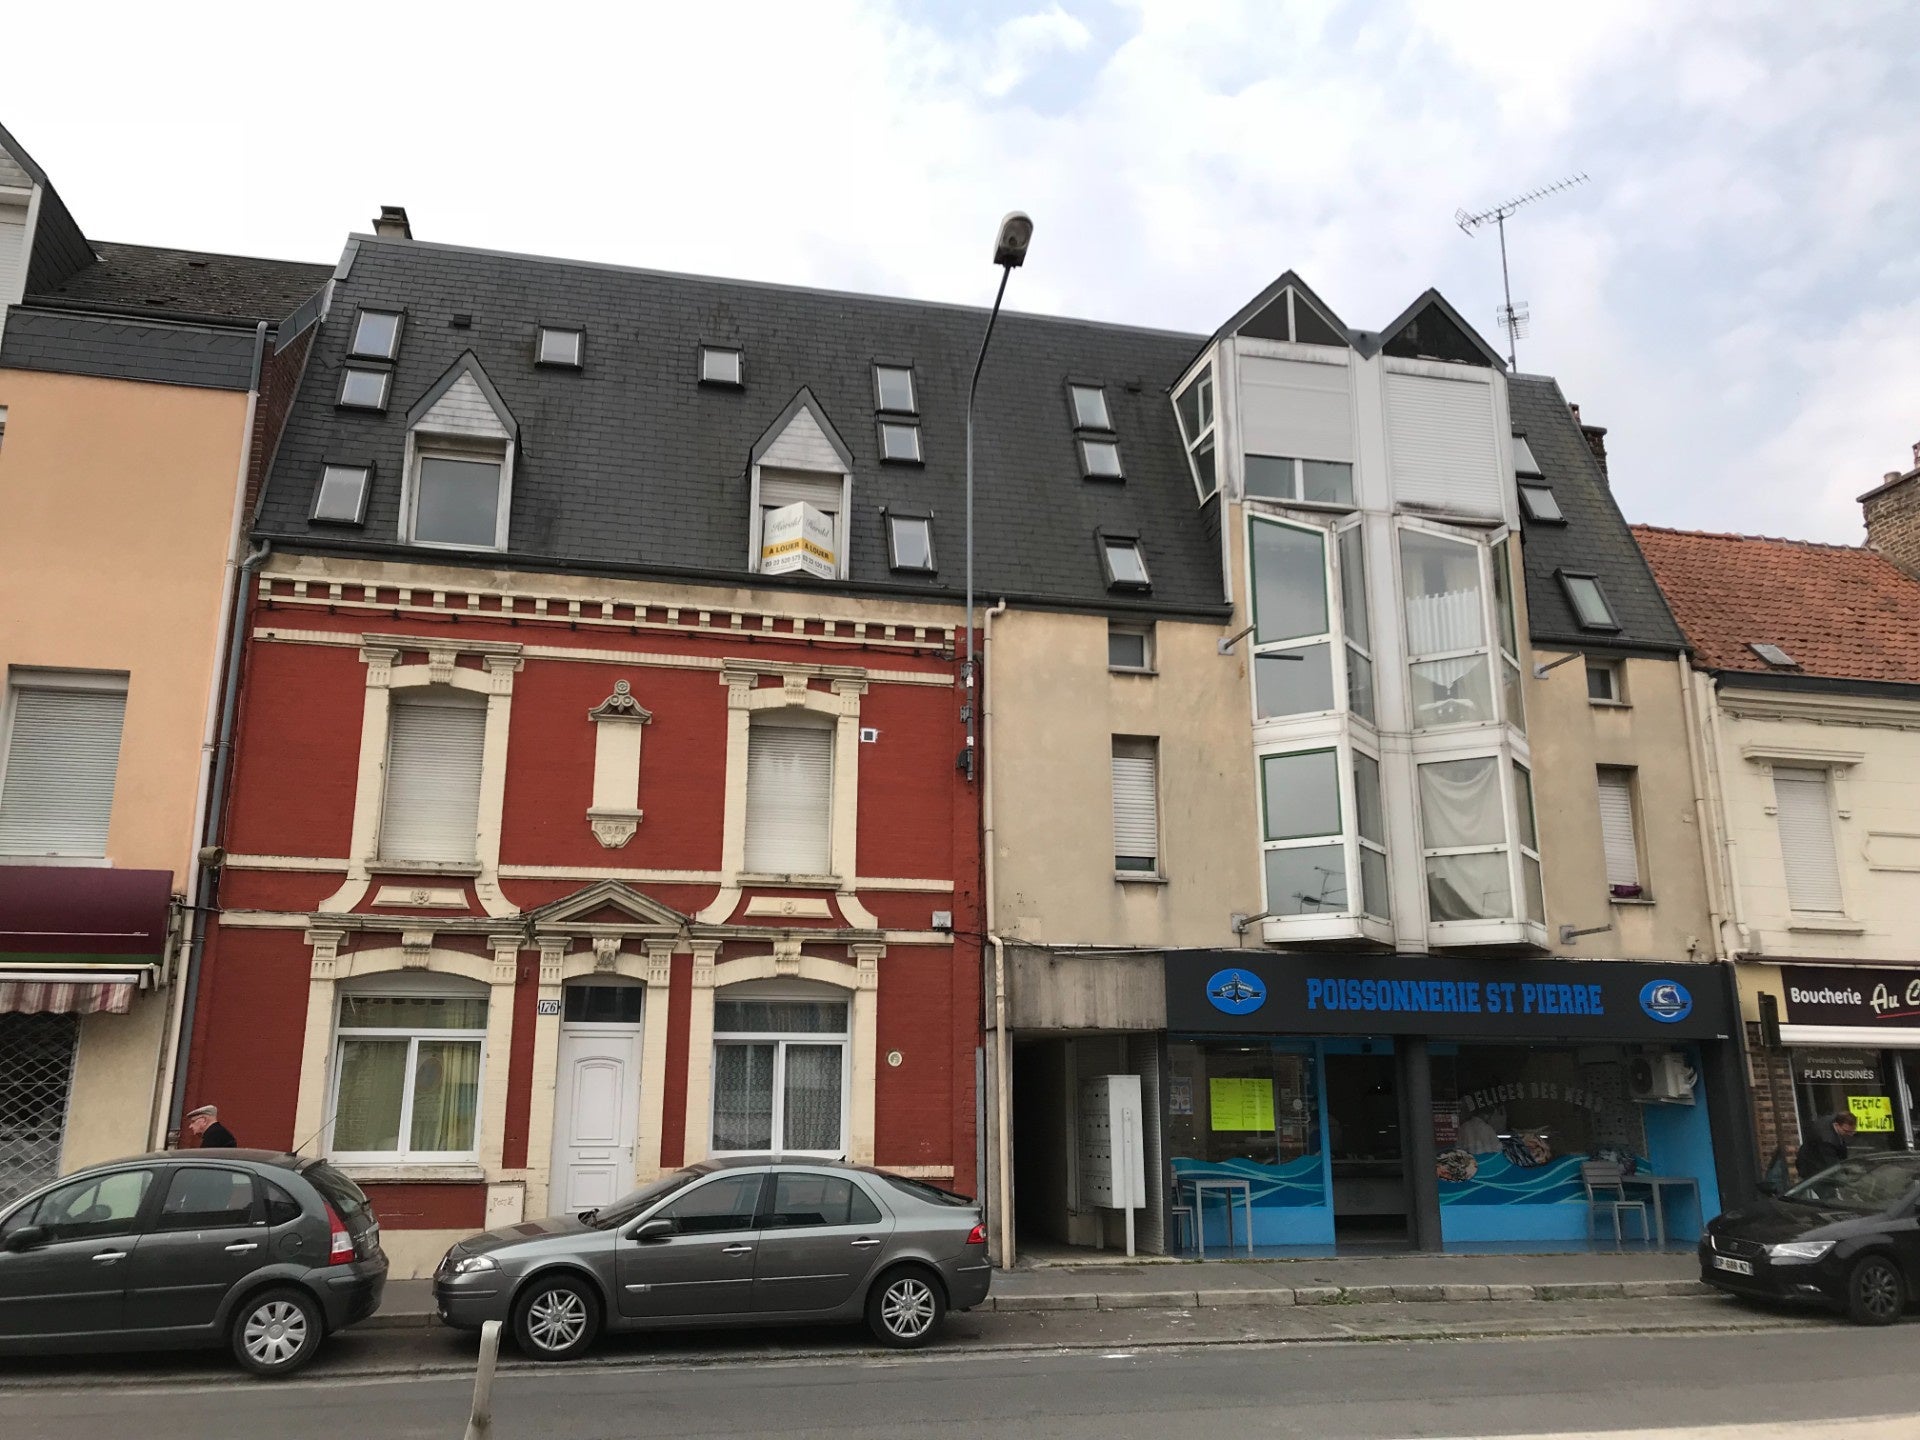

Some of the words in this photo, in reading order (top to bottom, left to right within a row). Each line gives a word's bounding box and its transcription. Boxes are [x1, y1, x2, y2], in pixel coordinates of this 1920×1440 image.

[776, 542, 800, 554] LOUER
[809, 545, 830, 560] LOUER
[1307, 978, 1481, 1012] POISSONNERIE
[1486, 982, 1516, 1013] ST
[1521, 983, 1604, 1015] PIERRE
[1790, 987, 1862, 1005] Boucherie
[1870, 983, 1900, 1014] Au
[540, 1002, 557, 1013] 176
[1804, 1069, 1832, 1079] PLATS
[1528, 1082, 1558, 1100] DES
